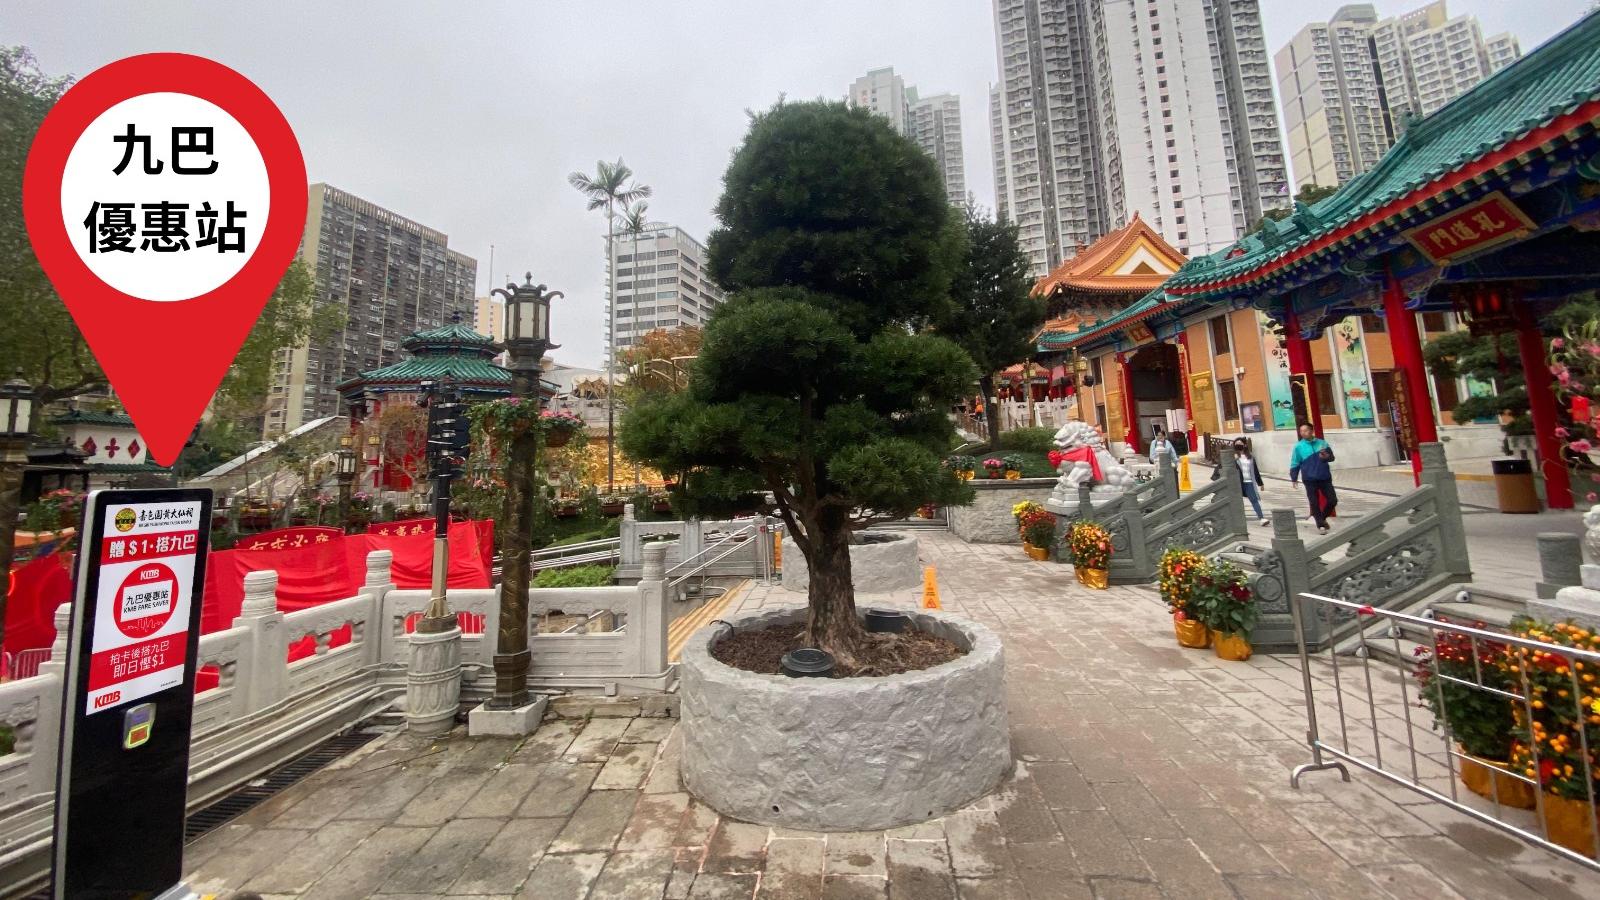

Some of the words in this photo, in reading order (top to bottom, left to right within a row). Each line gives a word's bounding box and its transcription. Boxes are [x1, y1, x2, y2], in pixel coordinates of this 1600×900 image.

[140, 569, 160, 580] KMB
[126, 590, 169, 606] 九巴優惠站
[123, 605, 137, 613] KMB
[110, 640, 170, 666] 拍卡後搭九巴
[113, 653, 165, 678] 即日慳$1
[94, 690, 121, 709] KMB
